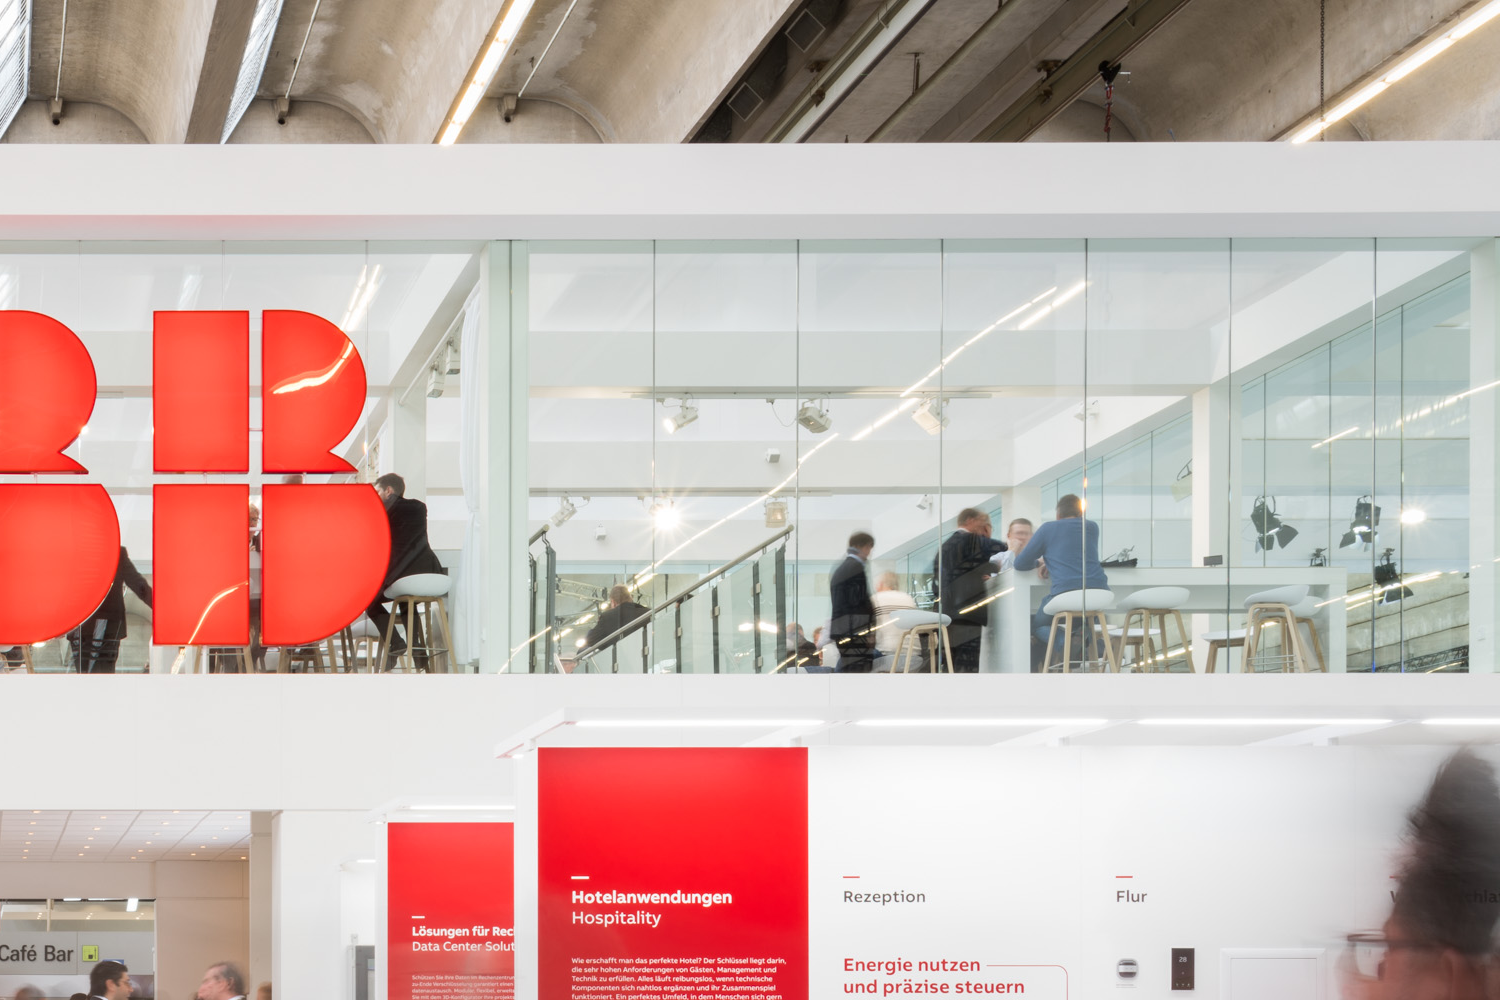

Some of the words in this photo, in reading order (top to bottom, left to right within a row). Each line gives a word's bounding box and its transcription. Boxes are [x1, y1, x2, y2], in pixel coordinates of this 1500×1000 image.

[572, 890, 732, 907] Hotelanwendungen
[843, 890, 926, 906] Rezeption
[1116, 890, 1147, 902] Flur
[572, 910, 661, 928] Hospitality
[412, 926, 469, 938] Lösungen
[472, 926, 489, 936] für
[44, 945, 74, 962] Bar
[412, 942, 440, 952] Data
[443, 942, 482, 952] Center
[485, 941, 515, 952] Solut
[843, 958, 913, 974] Energie
[918, 960, 981, 972] nutzen
[843, 980, 878, 994] und
[883, 980, 950, 998] präzise
[955, 982, 1025, 994] steuern
